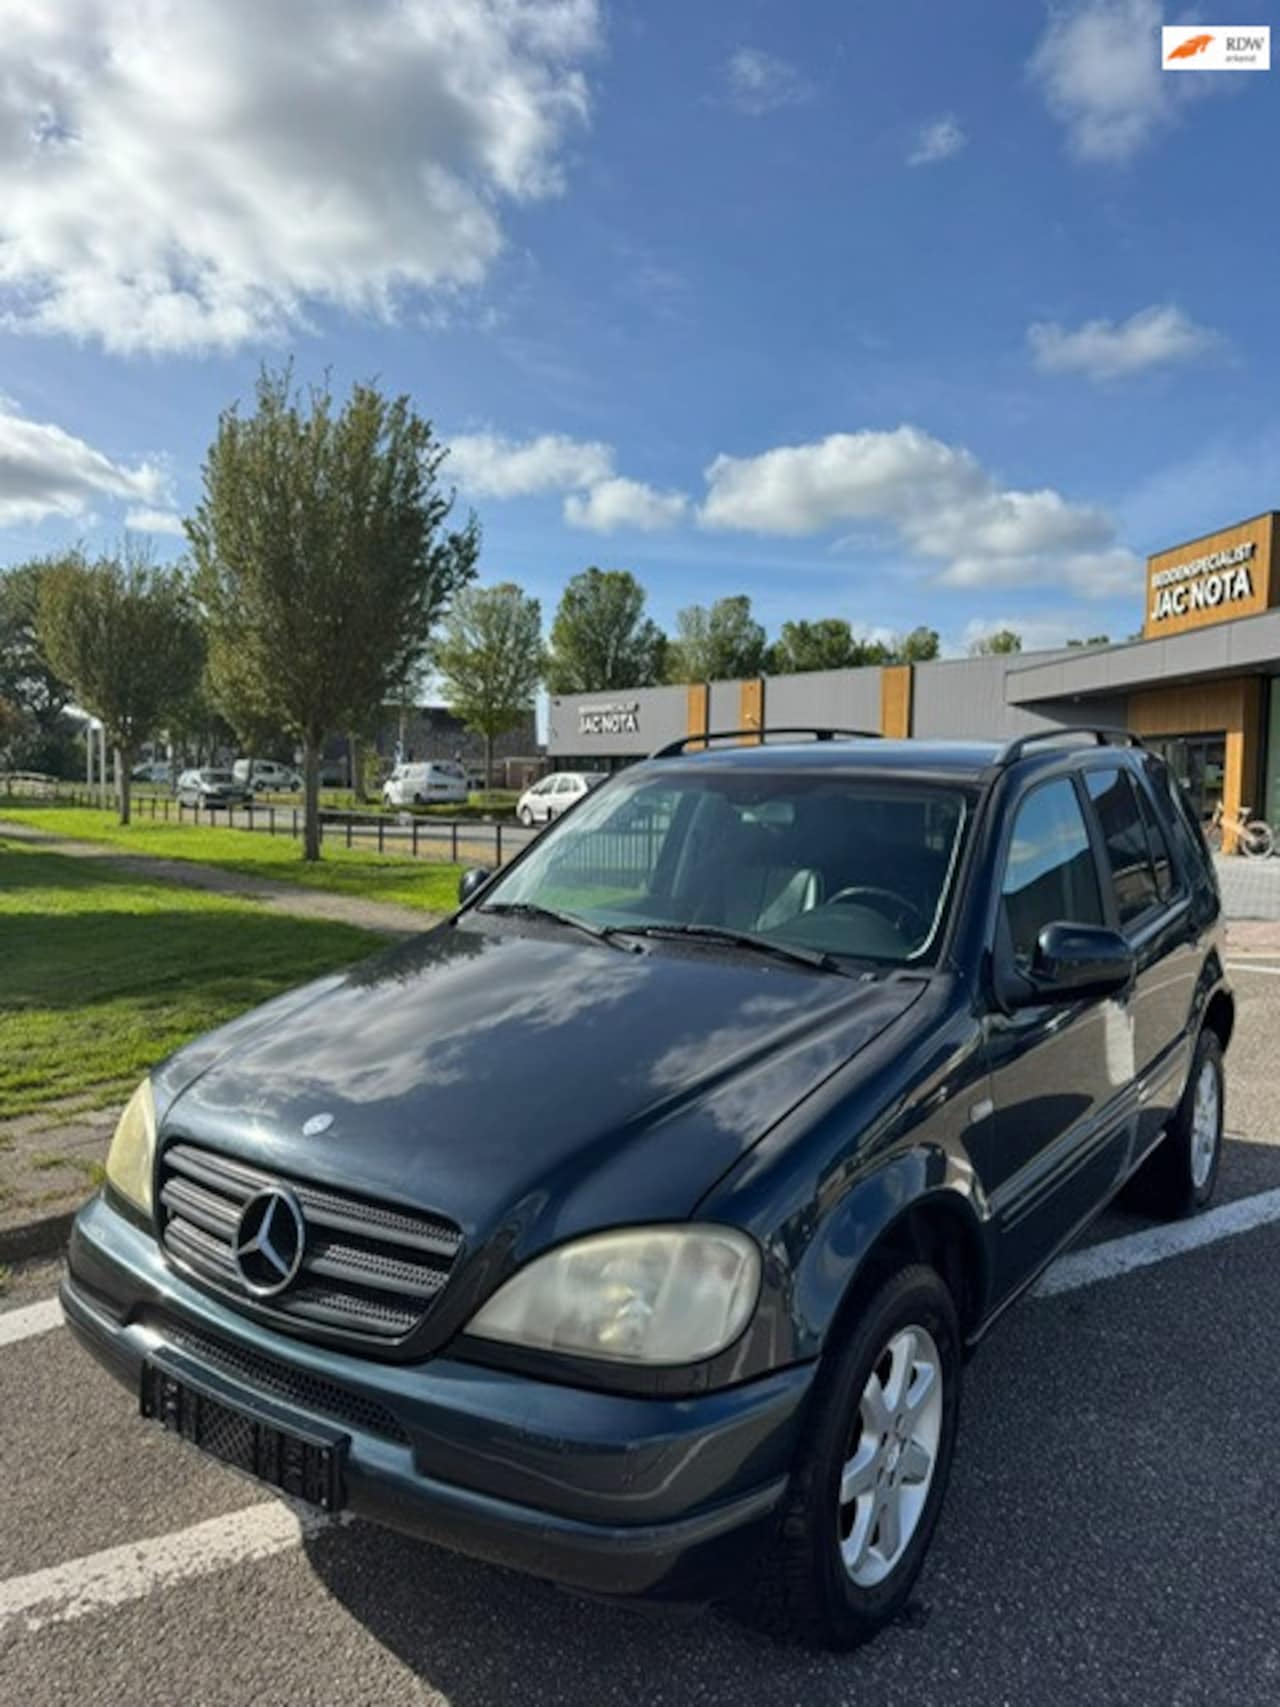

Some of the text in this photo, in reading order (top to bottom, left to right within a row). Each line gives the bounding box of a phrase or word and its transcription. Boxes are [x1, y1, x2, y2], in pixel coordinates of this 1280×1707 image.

[1151, 567, 1252, 620] JAC NOTA
[602, 713, 638, 732] NOTA
